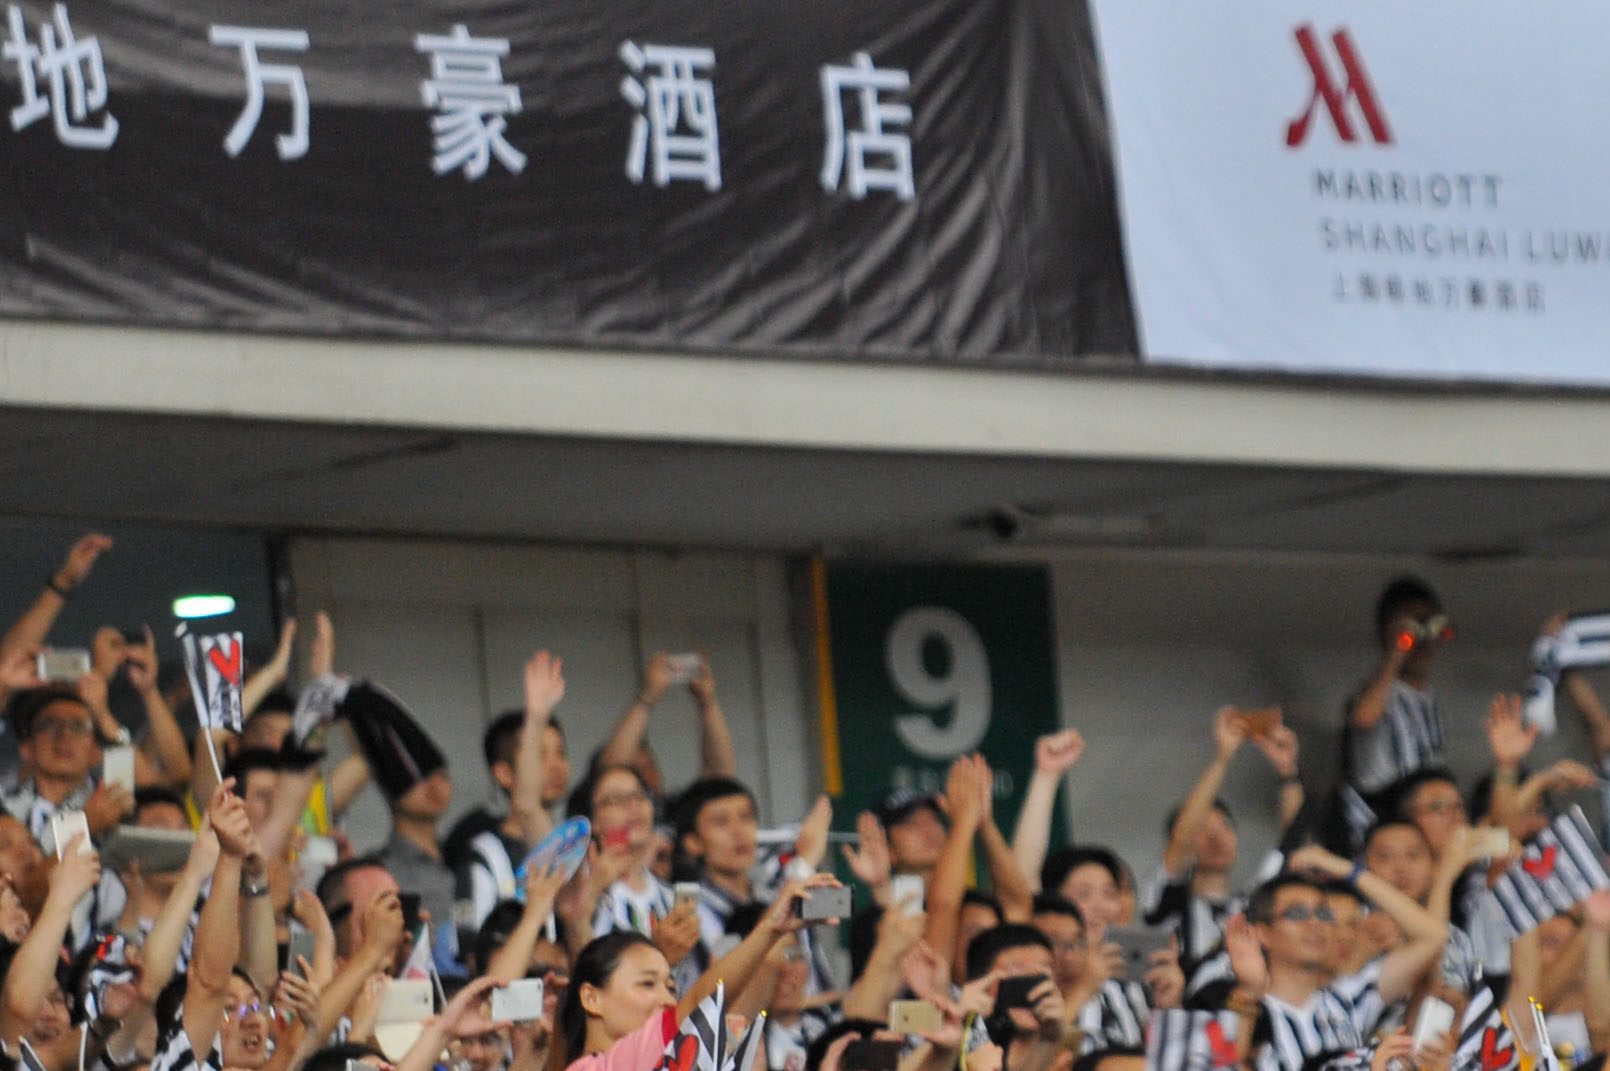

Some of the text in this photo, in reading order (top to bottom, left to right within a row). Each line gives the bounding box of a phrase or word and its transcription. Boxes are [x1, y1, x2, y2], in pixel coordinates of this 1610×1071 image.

[3, 2, 916, 198] 地万豪酒店
[1313, 169, 1503, 208] MARRIOTT
[1319, 215, 1510, 259] SHANGHAI
[886, 605, 993, 759] 9
